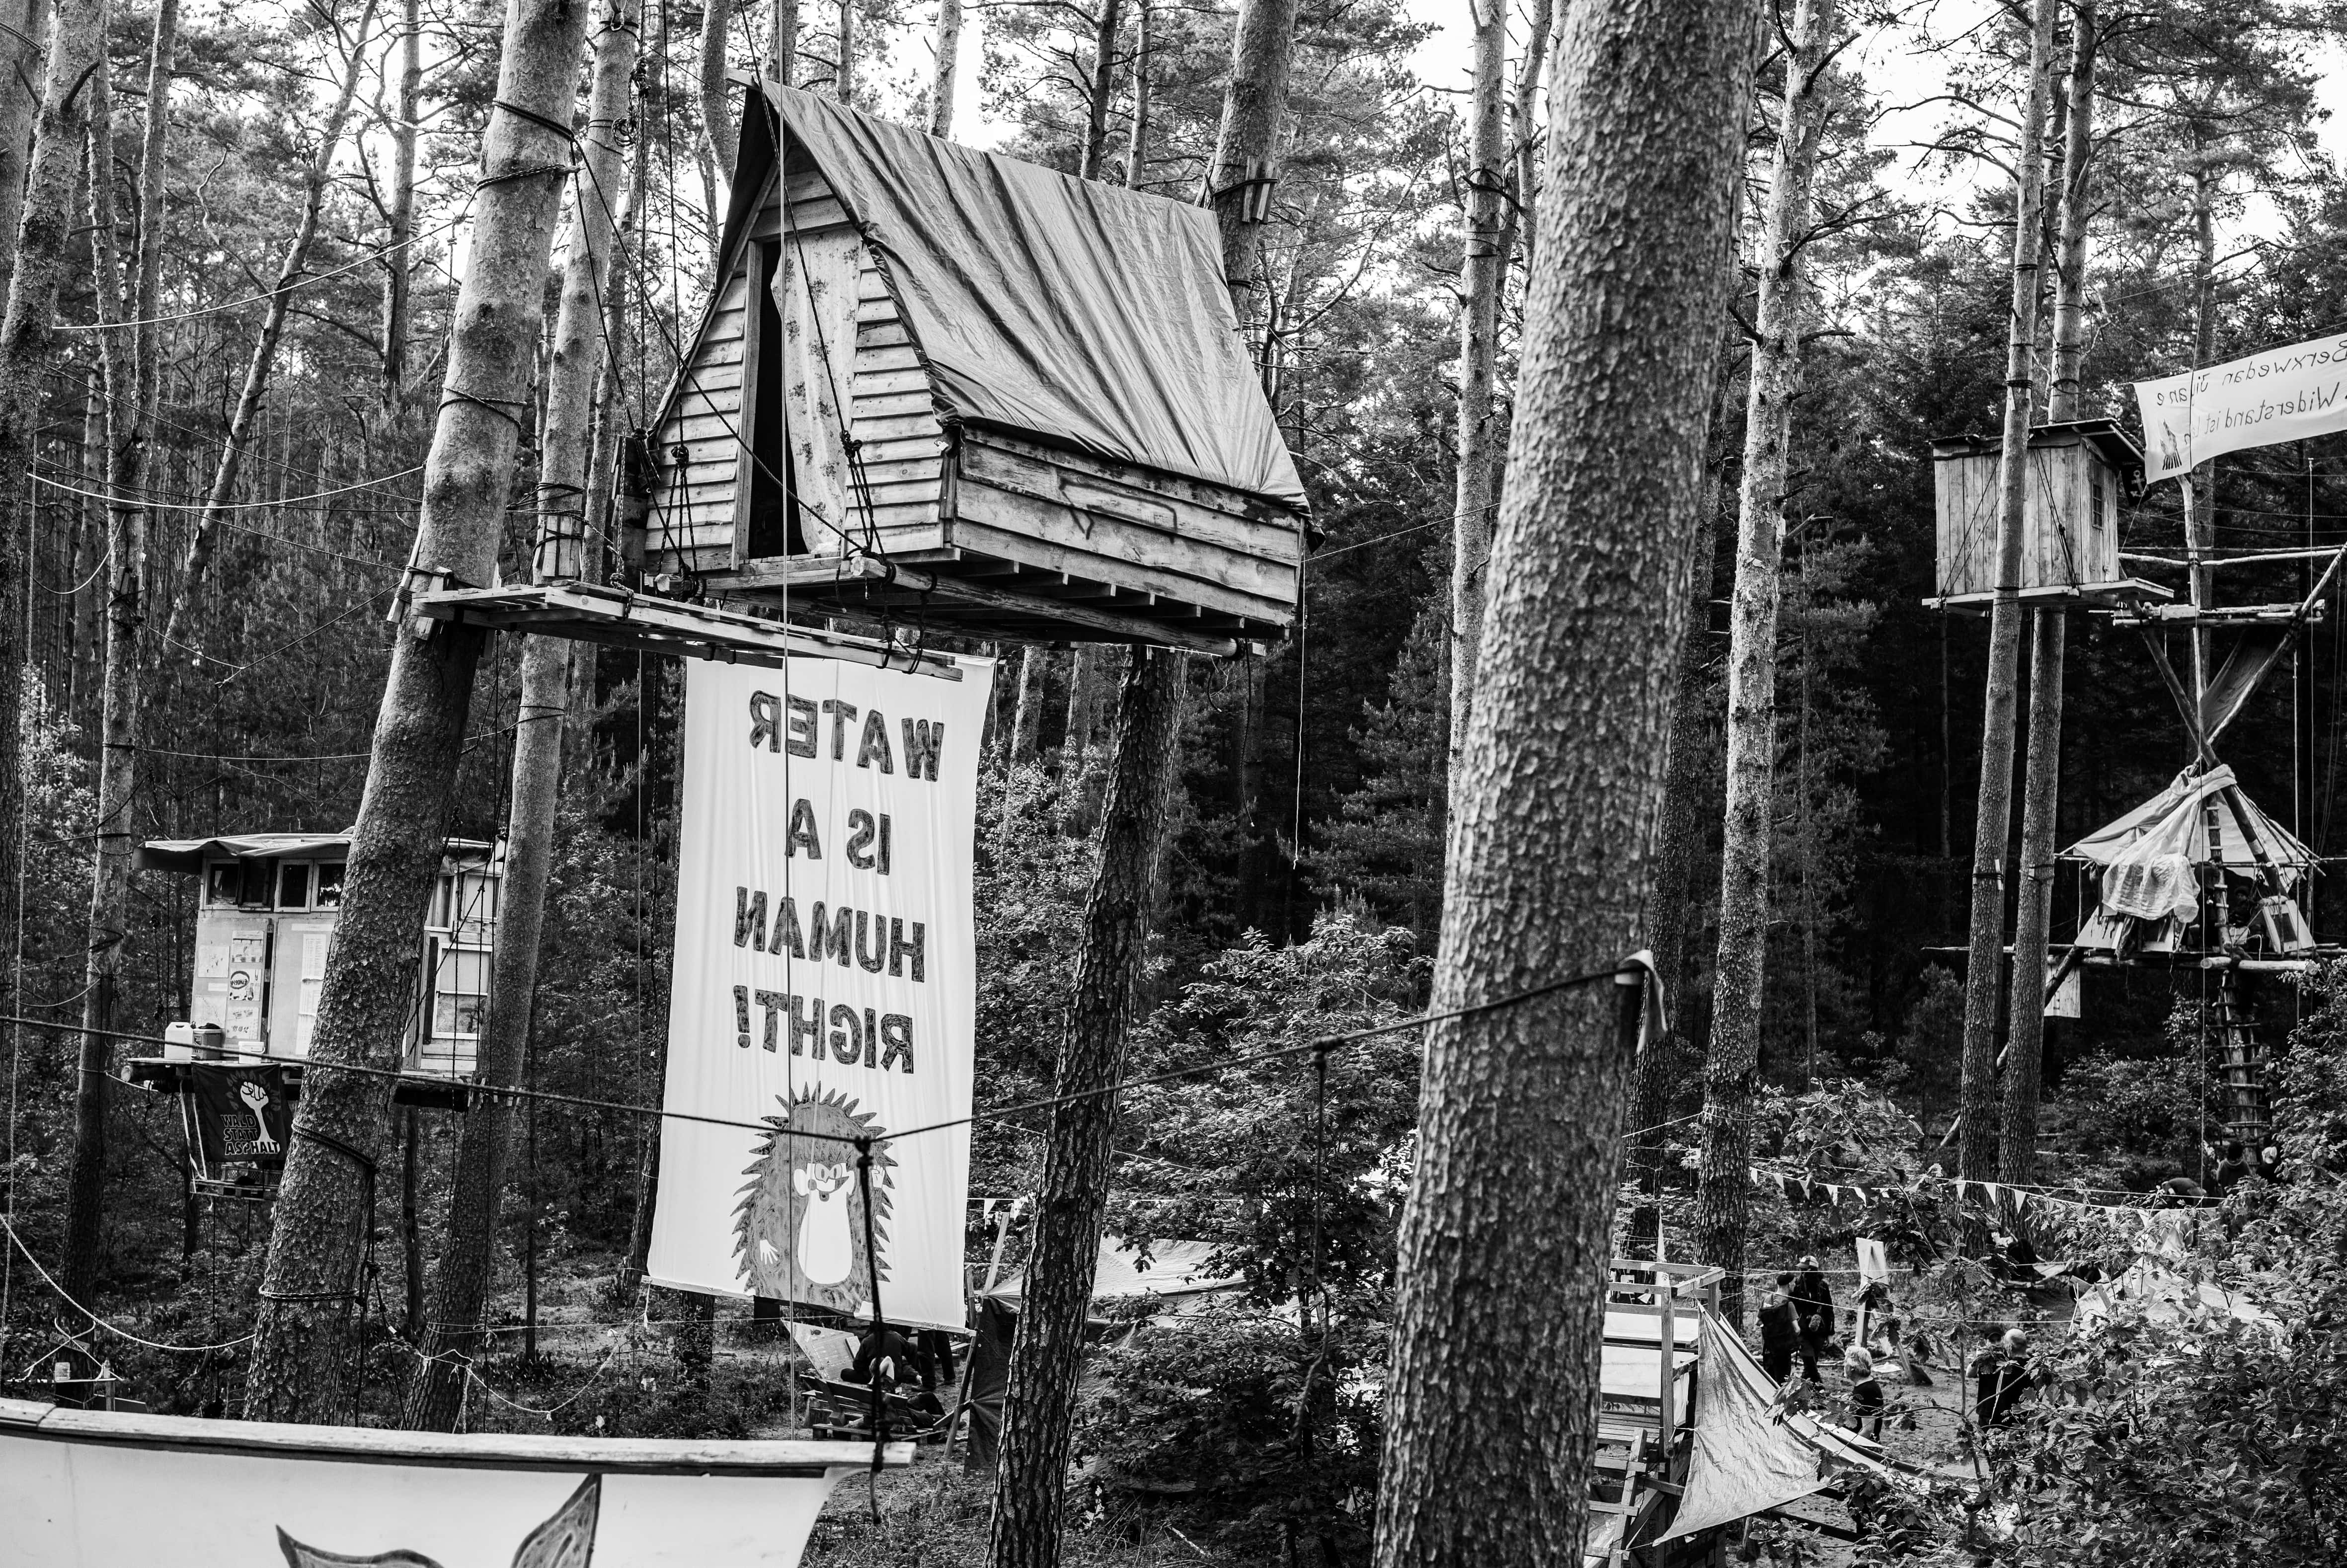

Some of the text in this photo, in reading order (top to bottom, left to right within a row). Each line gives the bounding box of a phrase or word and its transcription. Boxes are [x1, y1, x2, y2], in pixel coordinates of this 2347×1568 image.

[220, 1114, 256, 1127] WALD
[224, 1128, 258, 1141] STATT
[225, 1141, 280, 1155] ASPHALT
